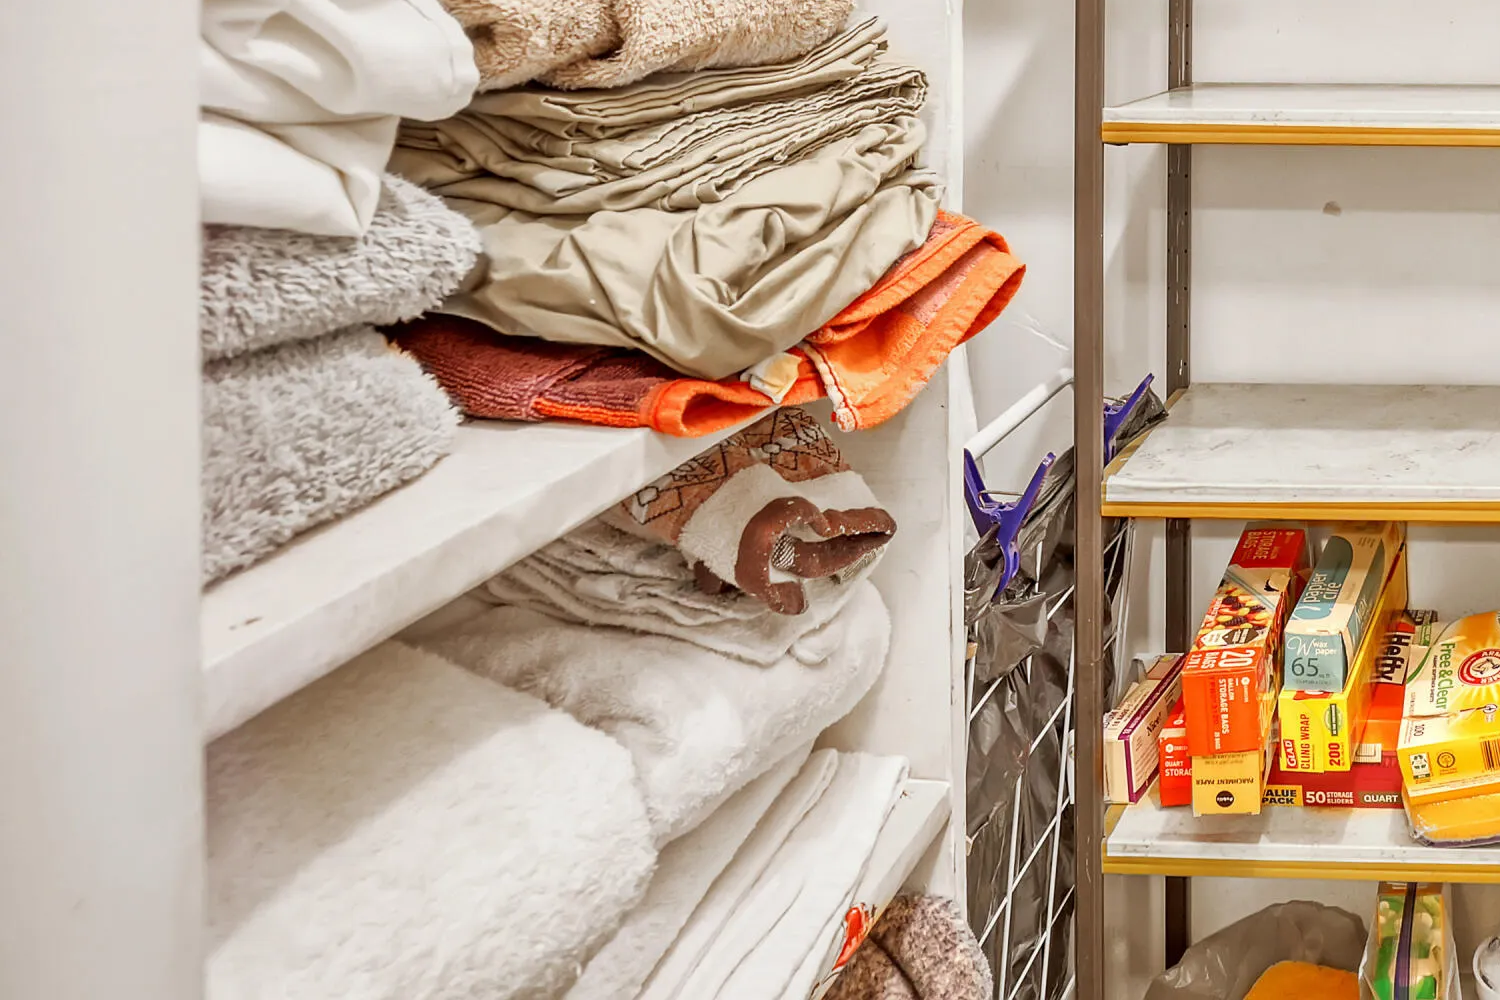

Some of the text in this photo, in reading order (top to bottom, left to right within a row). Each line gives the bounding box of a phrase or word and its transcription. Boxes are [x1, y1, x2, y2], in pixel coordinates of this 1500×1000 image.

[1303, 573, 1328, 603] papier
[1200, 651, 1220, 669] BAGS
[1217, 649, 1256, 668] 20
[1315, 648, 1337, 656] paper
[1291, 657, 1319, 677] 65
[1218, 678, 1230, 735] STORAGE BAGS
[1300, 713, 1311, 770] CLING WRAP
[1284, 740, 1298, 767] GLAD
[1328, 742, 1341, 767] 200
[1164, 760, 1184, 768] QUART
[1195, 778, 1255, 786] PARCHMENT PAPER
[1305, 791, 1326, 804] 50
[1363, 794, 1398, 803] QUART
